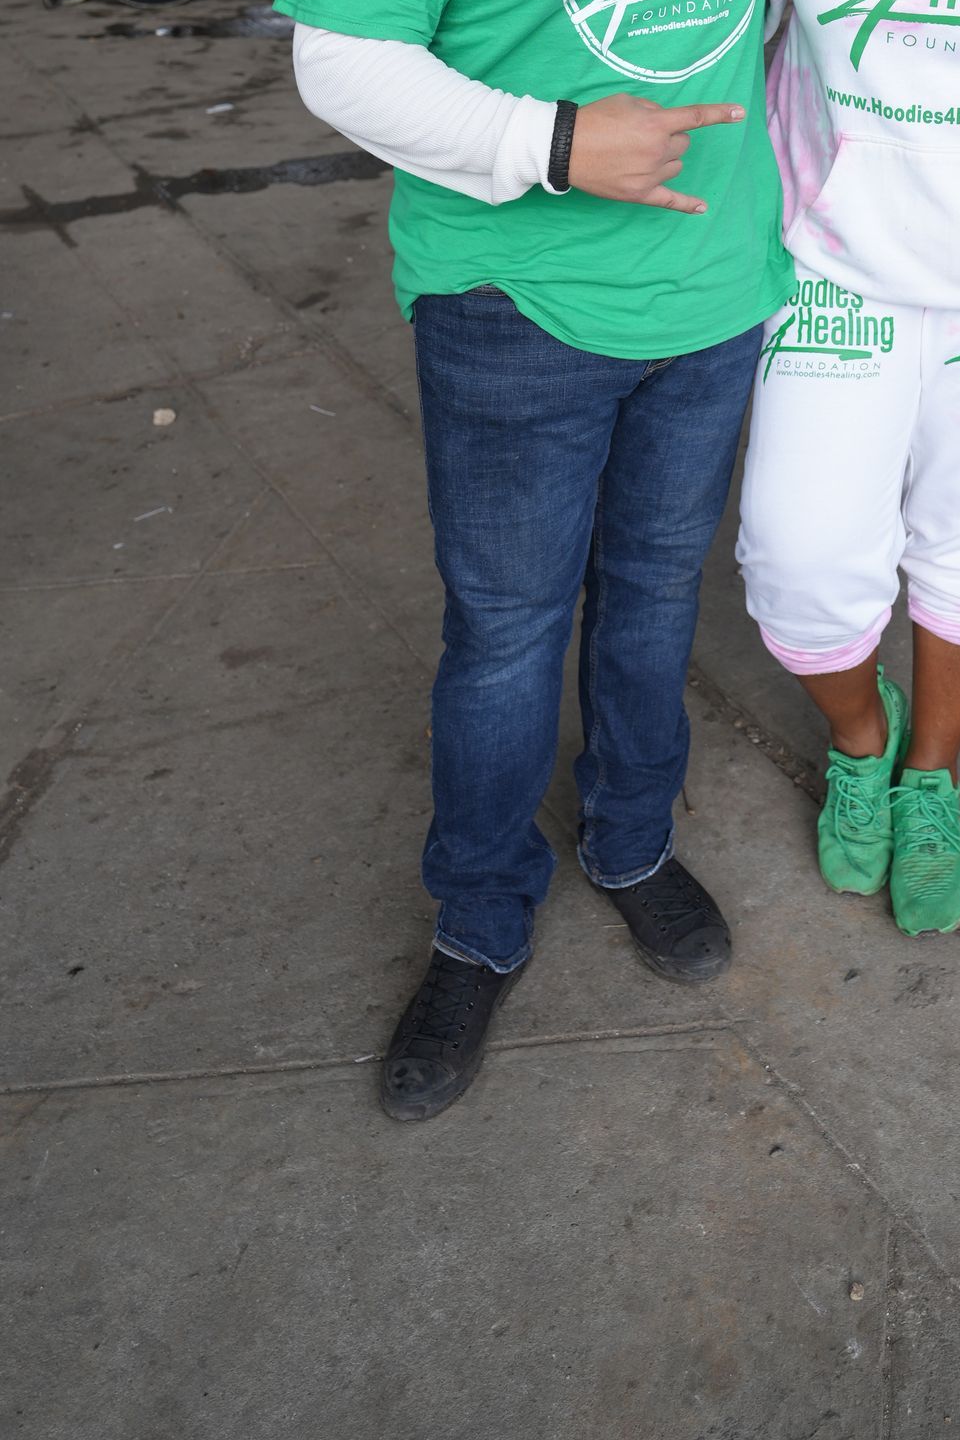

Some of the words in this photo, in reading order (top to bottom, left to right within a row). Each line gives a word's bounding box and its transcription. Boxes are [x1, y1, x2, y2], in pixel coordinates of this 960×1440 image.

[784, 277, 864, 309] oodies
[796, 306, 894, 353] Healing
[775, 368, 881, 380] www.hoodies4healing.com
[776, 359, 881, 371] FOUNDATION
